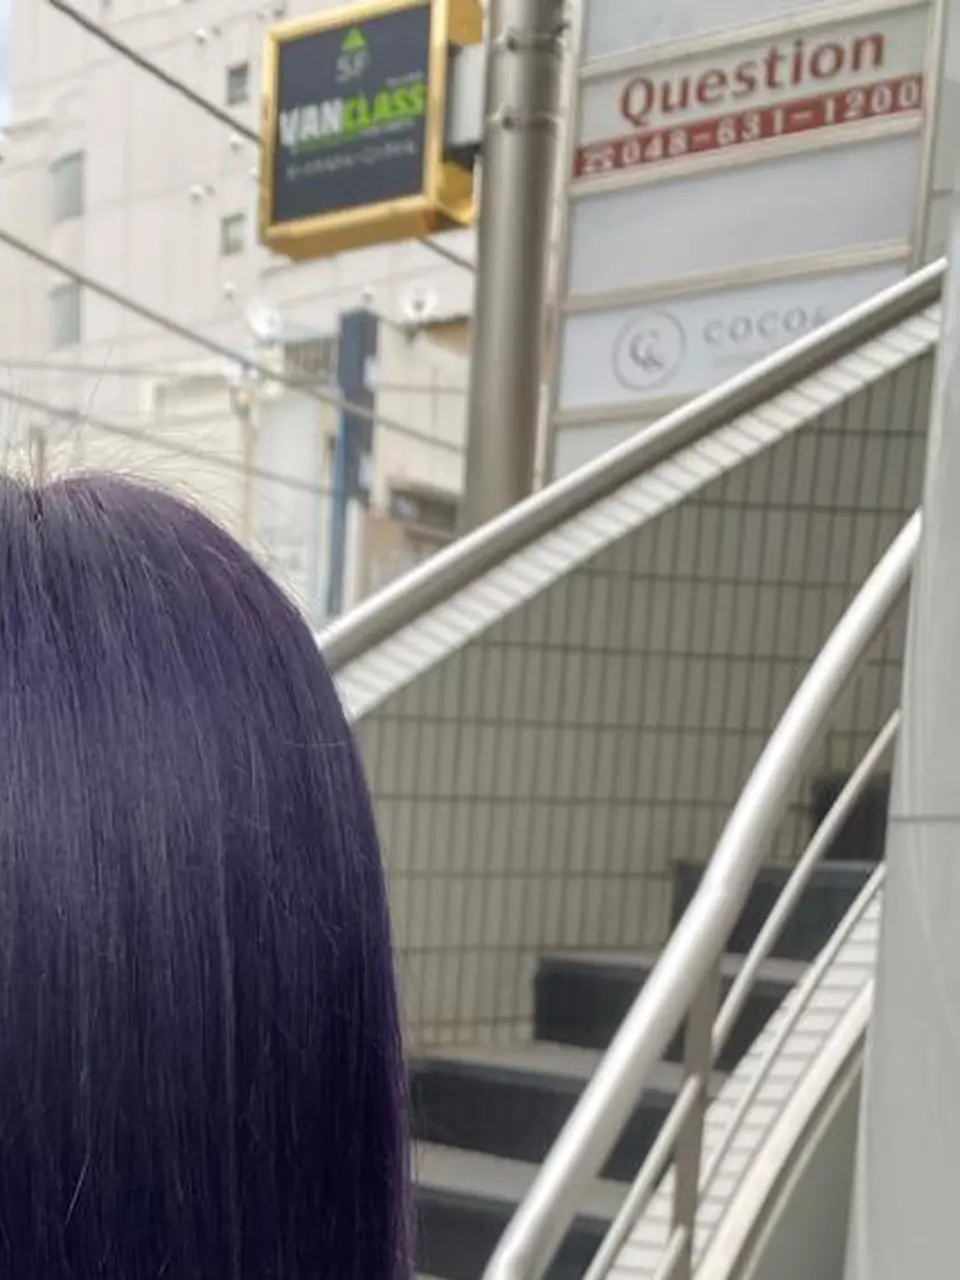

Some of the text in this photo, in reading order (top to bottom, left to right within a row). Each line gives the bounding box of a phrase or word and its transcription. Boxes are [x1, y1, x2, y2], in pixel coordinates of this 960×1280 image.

[279, 80, 428, 149] VANCLASS
[619, 32, 886, 127] Question
[621, 80, 920, 167] 048-631-1200
